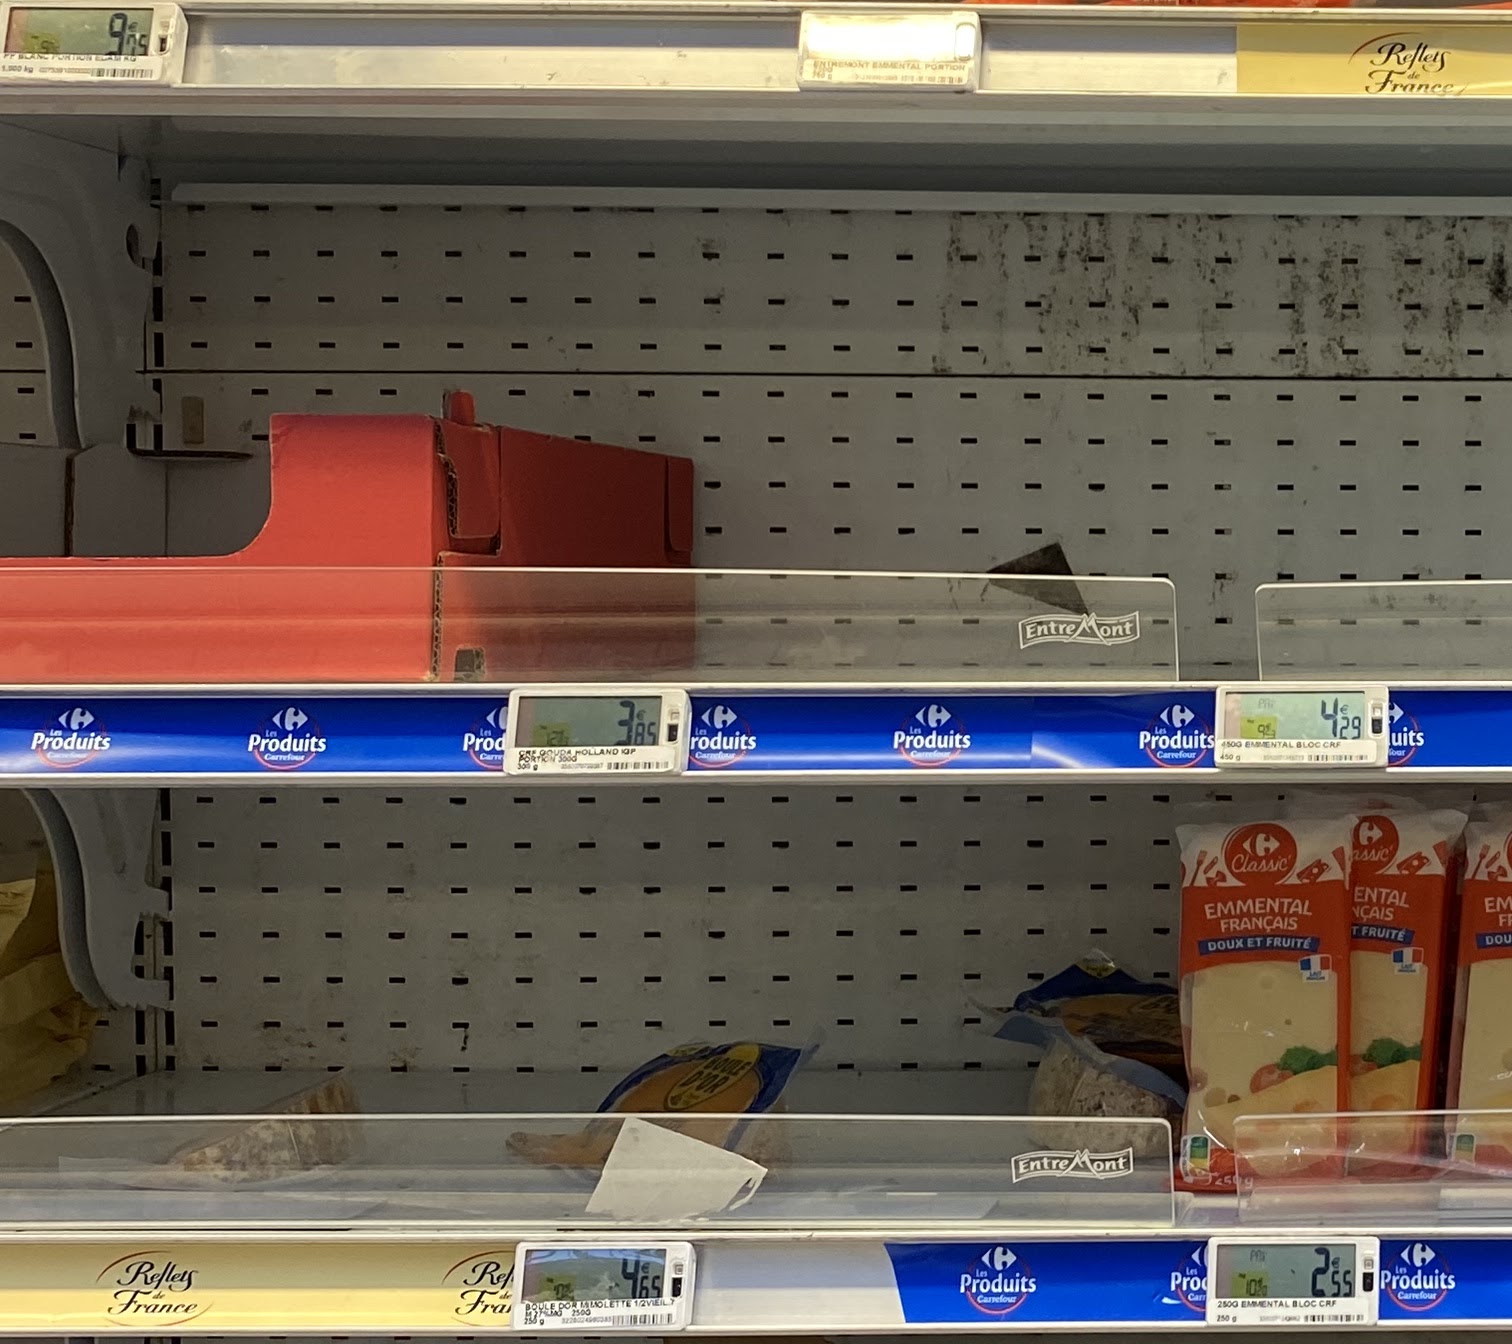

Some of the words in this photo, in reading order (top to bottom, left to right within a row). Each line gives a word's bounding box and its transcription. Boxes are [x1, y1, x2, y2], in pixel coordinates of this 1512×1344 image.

[1377, 39, 1452, 73] Reflets
[1365, 68, 1455, 95] France
[1026, 613, 1134, 645] EntreMont
[248, 731, 327, 754] Produits
[264, 729, 276, 737] Les
[266, 752, 306, 762] Carrefour
[1204, 897, 1313, 919] EMMENTAL
[1220, 914, 1298, 934] FRANÇAIS
[1207, 938, 1244, 951] DOUX
[1247, 938, 1261, 949] ET
[1264, 935, 1312, 949] FRUITÉ
[1019, 1149, 1128, 1178] EntreMont
[117, 1260, 200, 1291] Reflets
[976, 1268, 988, 1276] Les
[960, 1272, 1037, 1296] Produits
[108, 1287, 198, 1315] France
[580, 1300, 631, 1308] MIMOLETTE
[978, 1294, 1018, 1304] Carrefour
